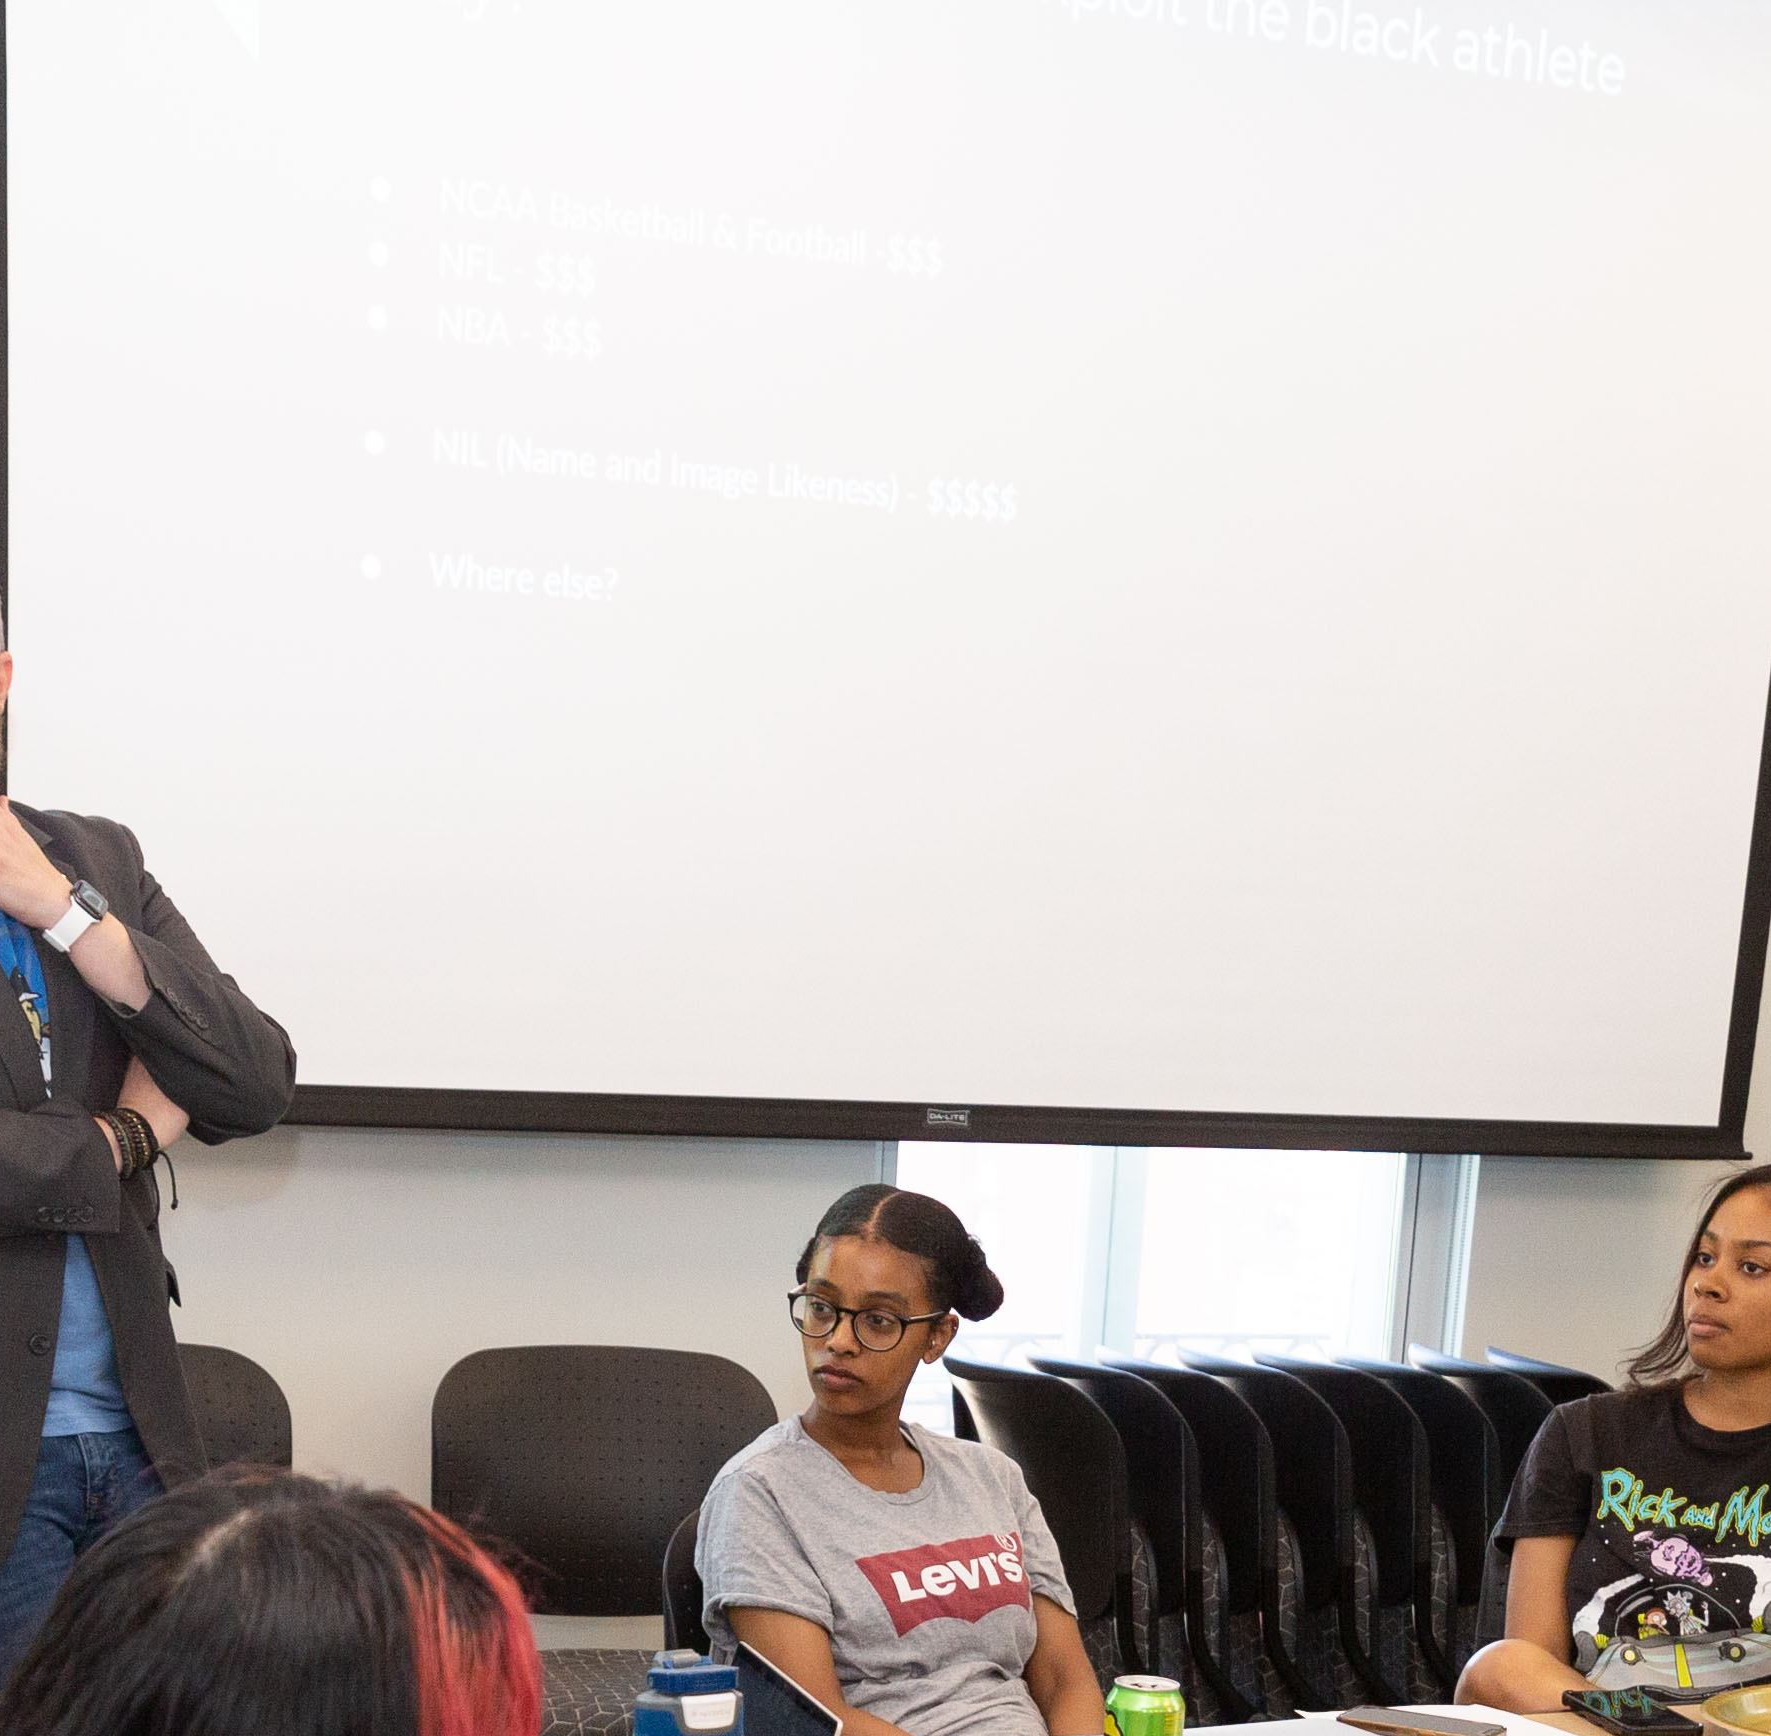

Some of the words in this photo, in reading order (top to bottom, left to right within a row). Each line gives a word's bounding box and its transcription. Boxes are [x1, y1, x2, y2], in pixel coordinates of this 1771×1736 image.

[1205, 0, 1289, 41] the
[1305, 0, 1443, 69] black
[1452, 22, 1626, 97] athlete
[439, 176, 540, 224] NCAA
[549, 191, 707, 248] Basketball
[712, 211, 737, 253] &
[747, 217, 867, 266] Football
[438, 240, 506, 285] NFL
[534, 248, 596, 299] $$$
[437, 304, 510, 348] NBA
[541, 312, 604, 363] $$$
[432, 426, 490, 469] NIL
[496, 432, 599, 479] (Name
[605, 448, 662, 487] and
[669, 450, 758, 500] Image
[767, 462, 898, 515] Likeness)
[925, 475, 1016, 525] $$$$$
[428, 550, 535, 597] Where
[543, 562, 619, 604] else?
[1596, 1467, 1688, 1532] Rick
[890, 1551, 1023, 1603] Levi's
